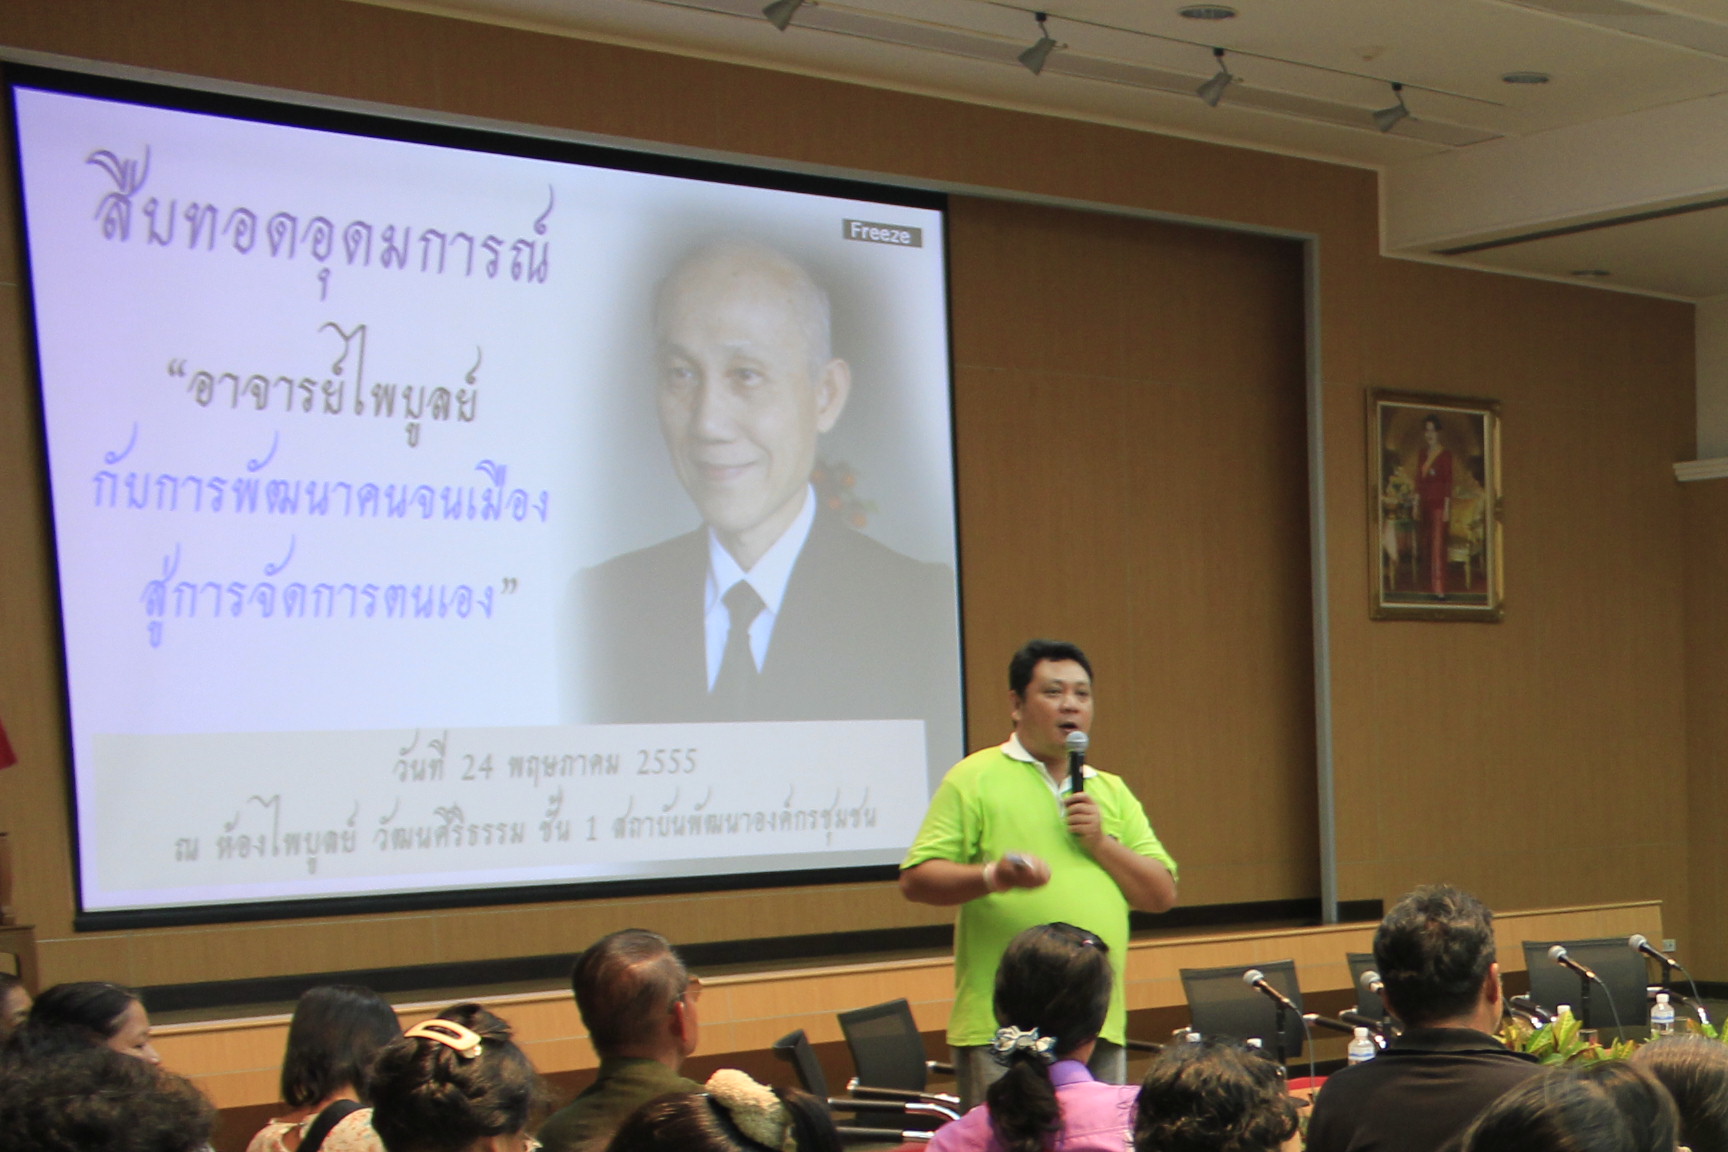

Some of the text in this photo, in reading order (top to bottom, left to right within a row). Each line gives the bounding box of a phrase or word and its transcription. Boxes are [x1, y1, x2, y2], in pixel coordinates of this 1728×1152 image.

[84, 144, 556, 301] สืบทอดอุดมการณ์
[850, 221, 911, 245] Freeze
[91, 421, 551, 524] กับการพัฒนาคนจนเมือง
[396, 730, 697, 788] วันที่ 24 พฤษภาคม 2555
[175, 783, 878, 875] ณ ห้องไพบูลย์ วัฒนศิริธรรม ชั้น 1 สถาบันพัฒนาองค์กรชุมชน
